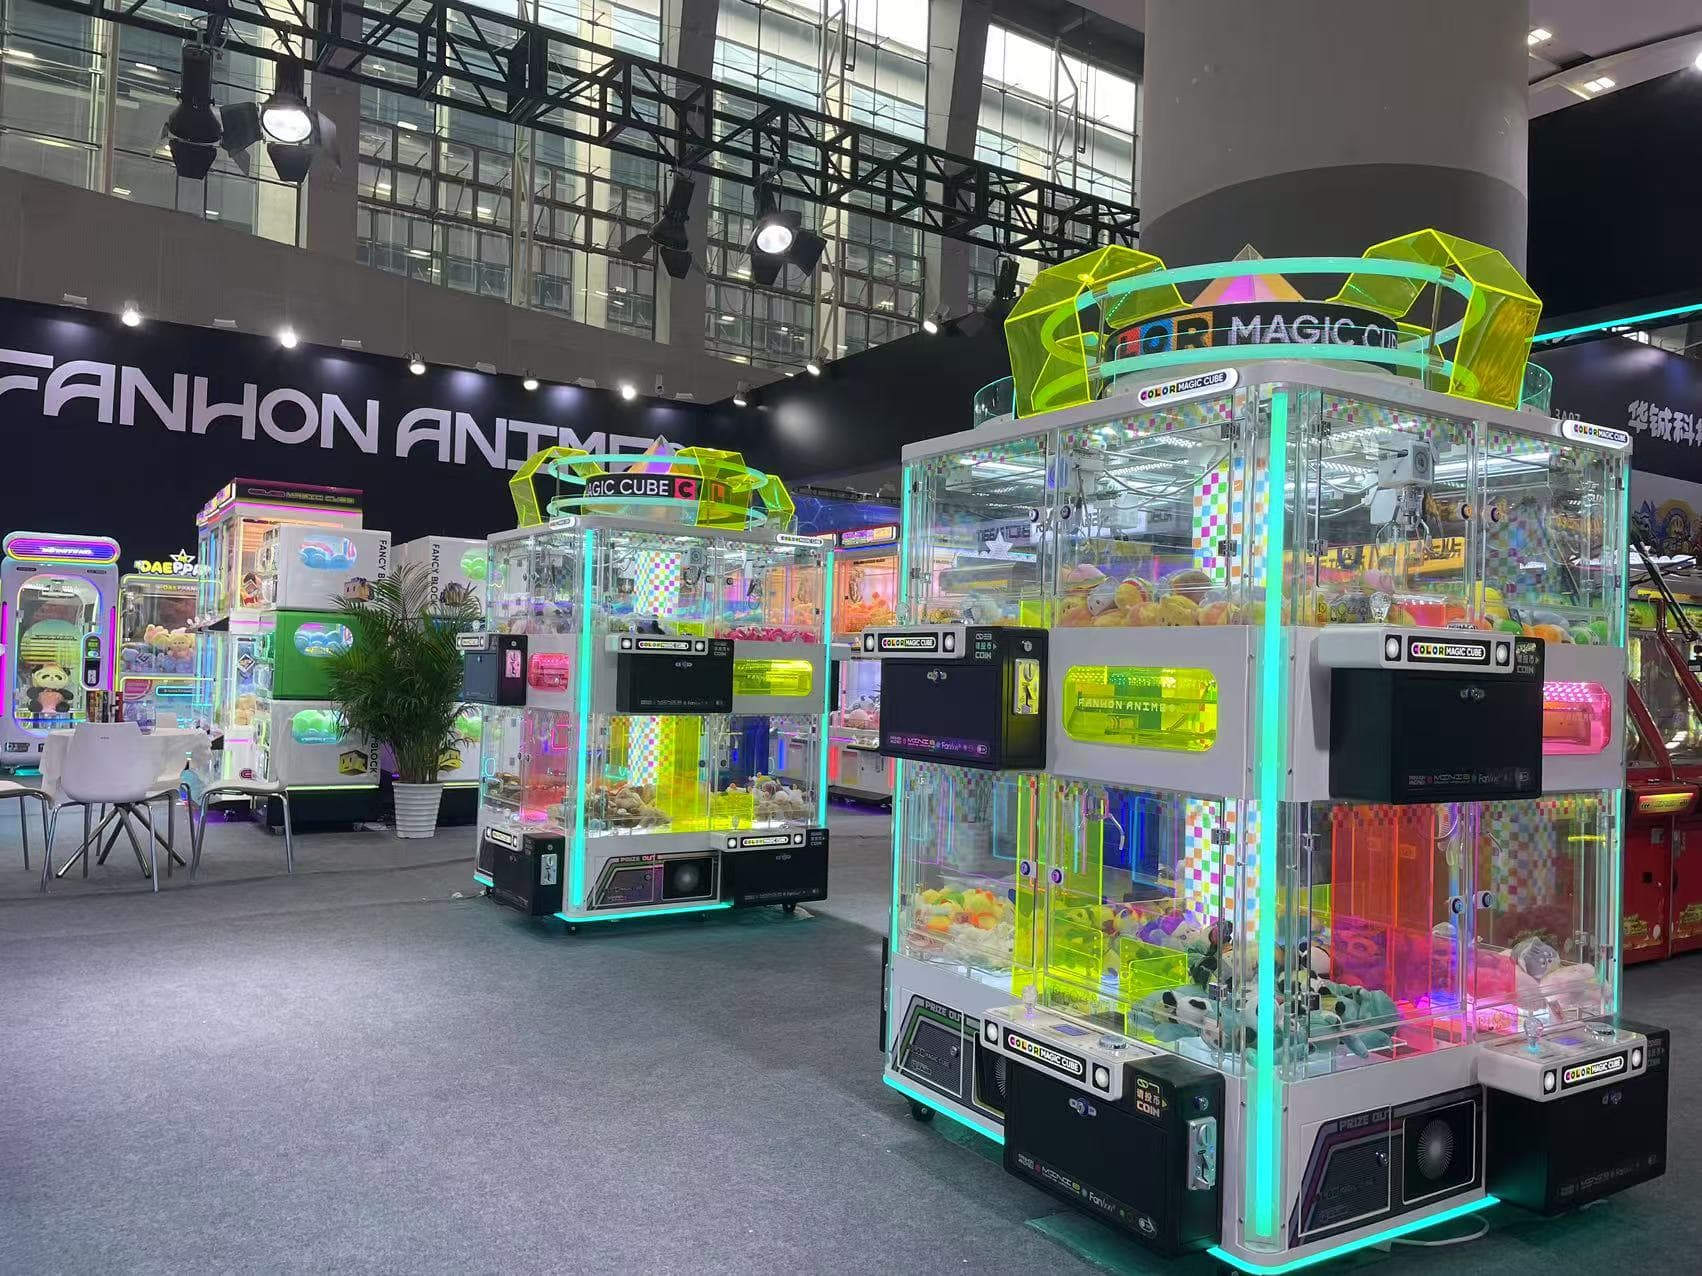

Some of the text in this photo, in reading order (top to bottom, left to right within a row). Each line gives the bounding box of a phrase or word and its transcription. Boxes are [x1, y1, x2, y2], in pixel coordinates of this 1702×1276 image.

[1227, 313, 1356, 346] MAGIC
[1140, 373, 1225, 401] COLOR MAGIC CUBE
[1573, 423, 1627, 443] COLOR MAGIC CUBE
[619, 479, 669, 496] CUBE
[378, 539, 388, 571] FANCY
[431, 543, 440, 574] FANCY
[882, 639, 906, 647] COLOR
[906, 639, 921, 647] MAGIC
[1412, 643, 1483, 658] COLOR MAGIC CUBE
[925, 1000, 947, 1017] PRIZE
[1009, 1036, 1079, 1072] COLOR MAGIC CUBE
[1565, 1058, 1621, 1082] COLOR MAGIC CUBE
[1136, 1100, 1160, 1118] COIN
[1340, 1114, 1369, 1131] PRIZE
